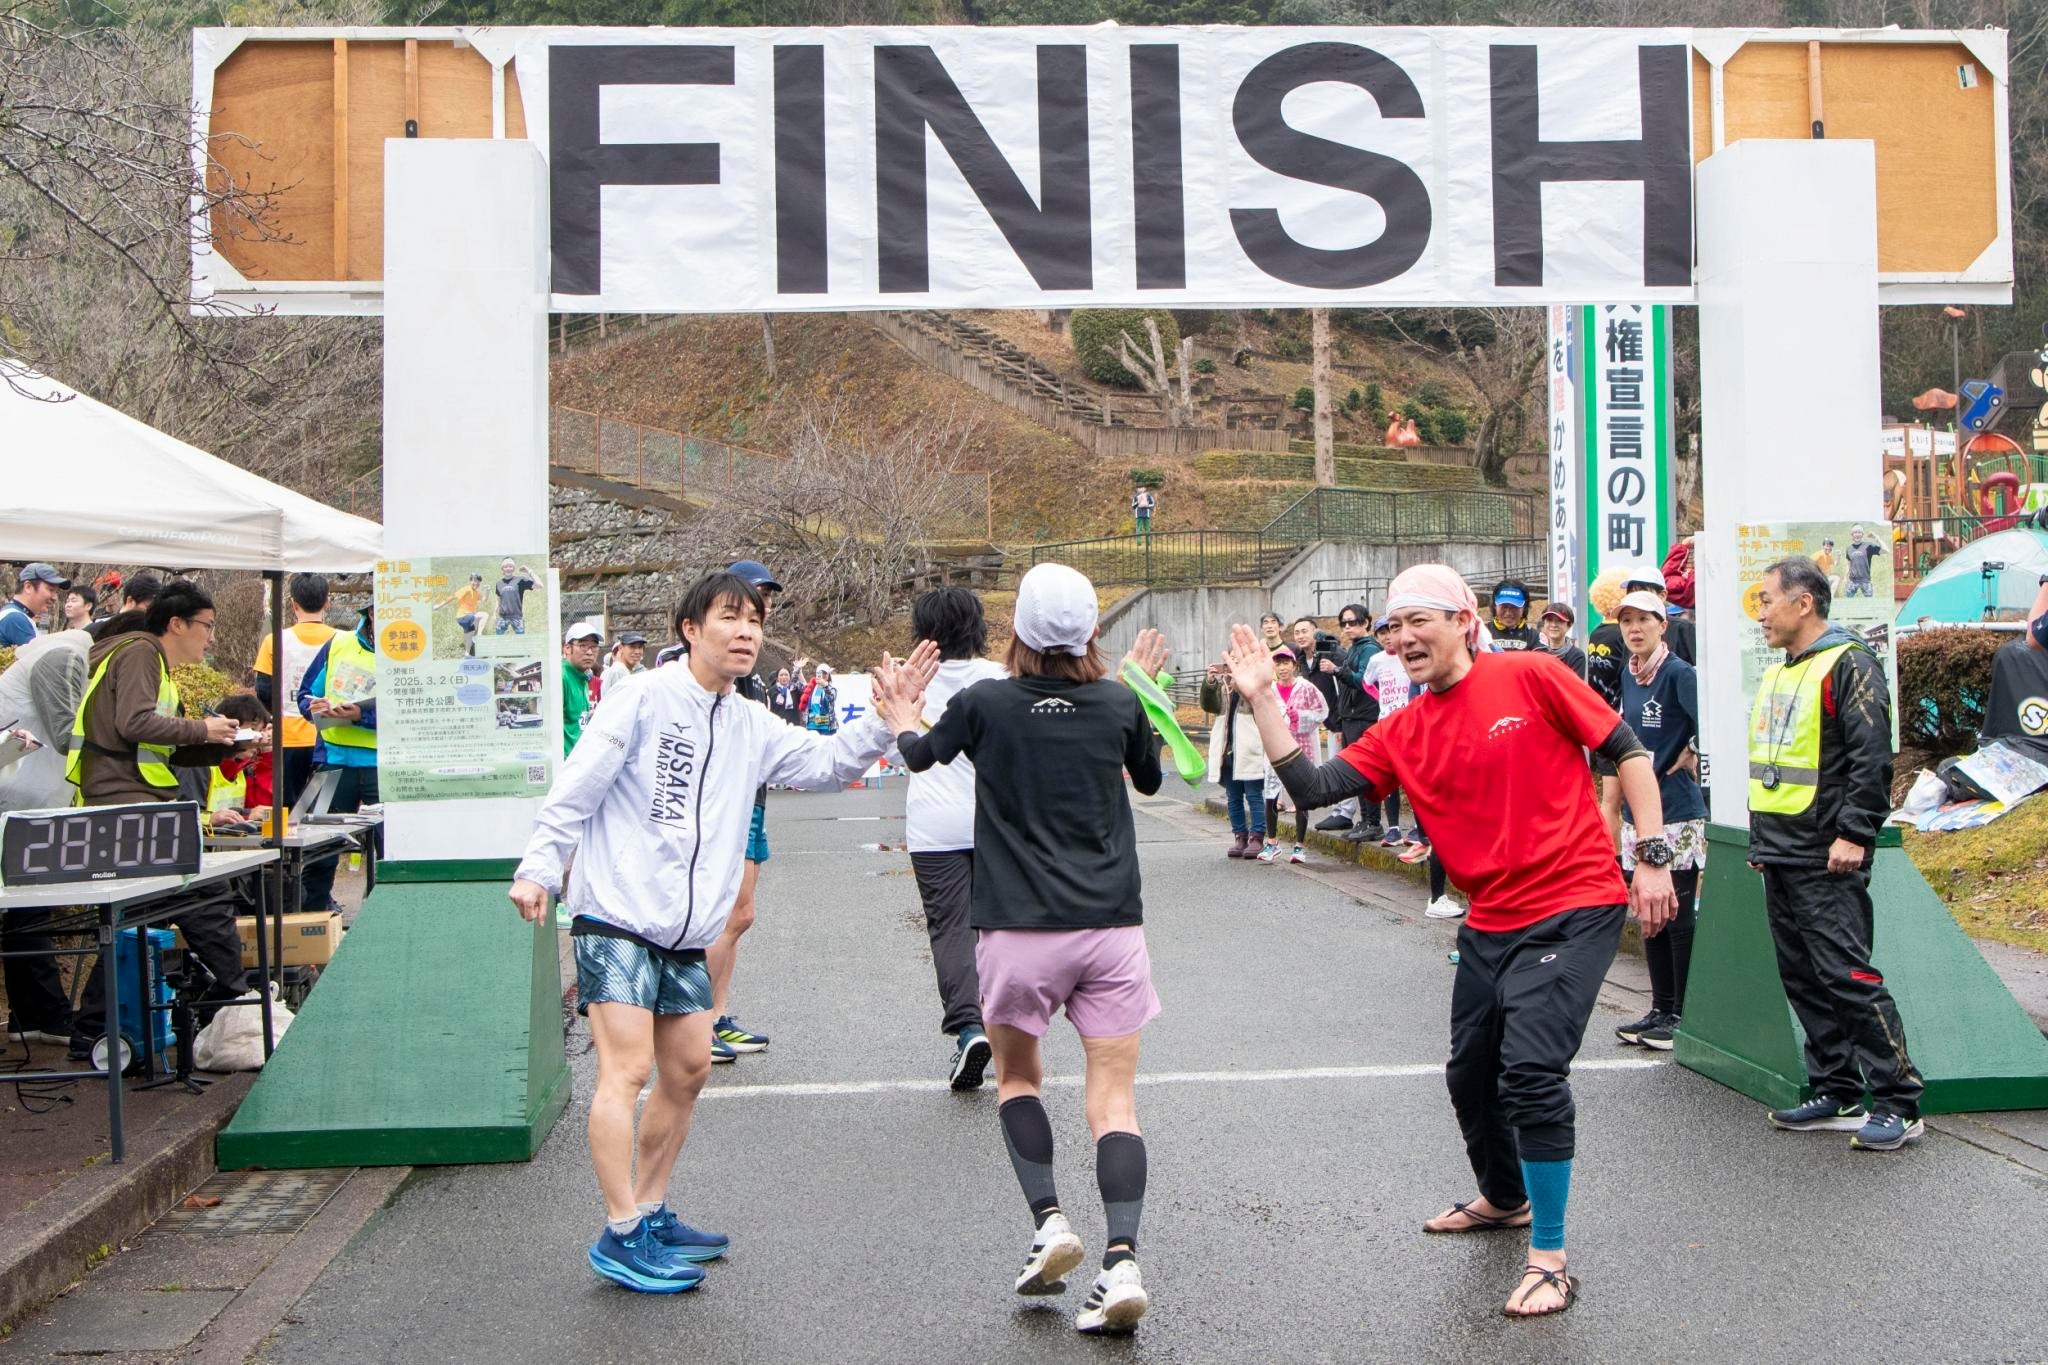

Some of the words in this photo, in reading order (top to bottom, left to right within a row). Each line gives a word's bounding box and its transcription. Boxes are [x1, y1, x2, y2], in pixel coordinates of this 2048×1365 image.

[549, 41, 1691, 296] FINISH
[1604, 305, 1647, 558] 権宣言の町
[377, 607, 413, 620] 2025
[395, 695, 455, 707] 下市中央公園
[608, 735, 626, 750] 2018
[650, 736, 673, 821] MARATHON
[664, 741, 695, 822] OSAKA
[23, 810, 181, 873] 28:00
